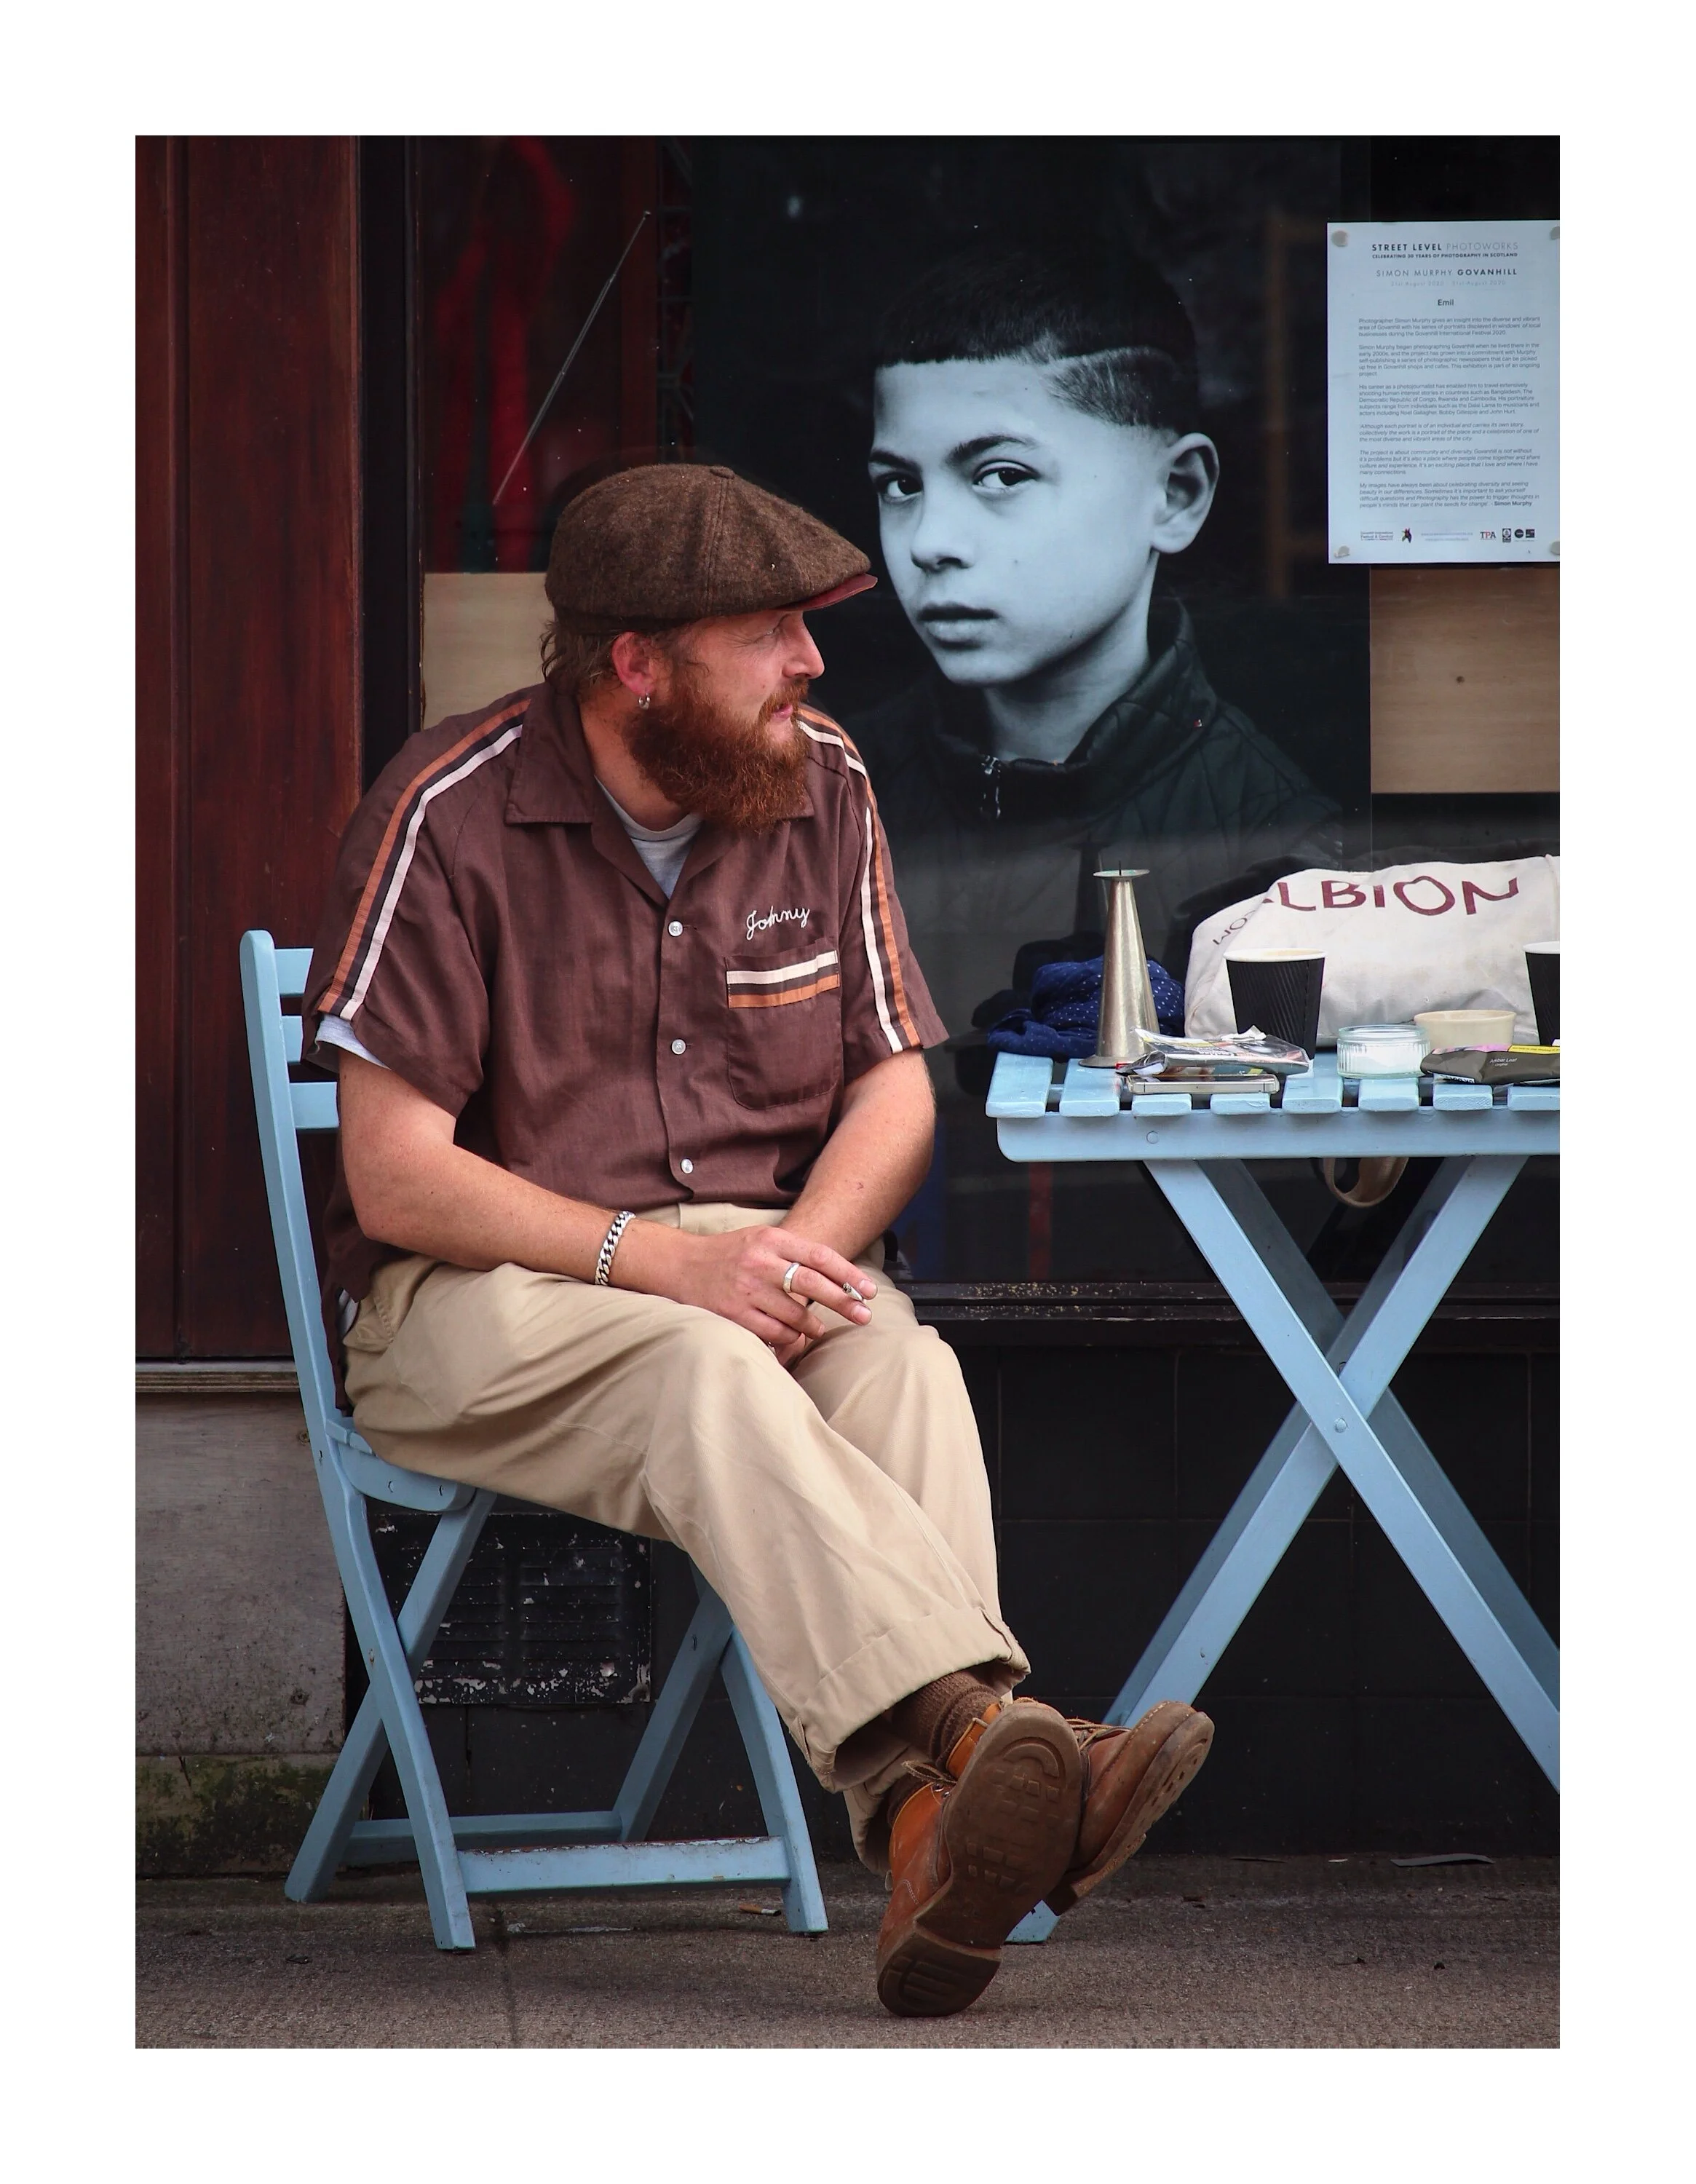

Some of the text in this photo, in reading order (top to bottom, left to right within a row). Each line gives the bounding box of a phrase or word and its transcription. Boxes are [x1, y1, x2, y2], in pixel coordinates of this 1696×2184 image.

[1446, 242, 1518, 250] PHOTOWORKS
[1261, 876, 1520, 916] LBION
[746, 906, 810, 940] Johnny
